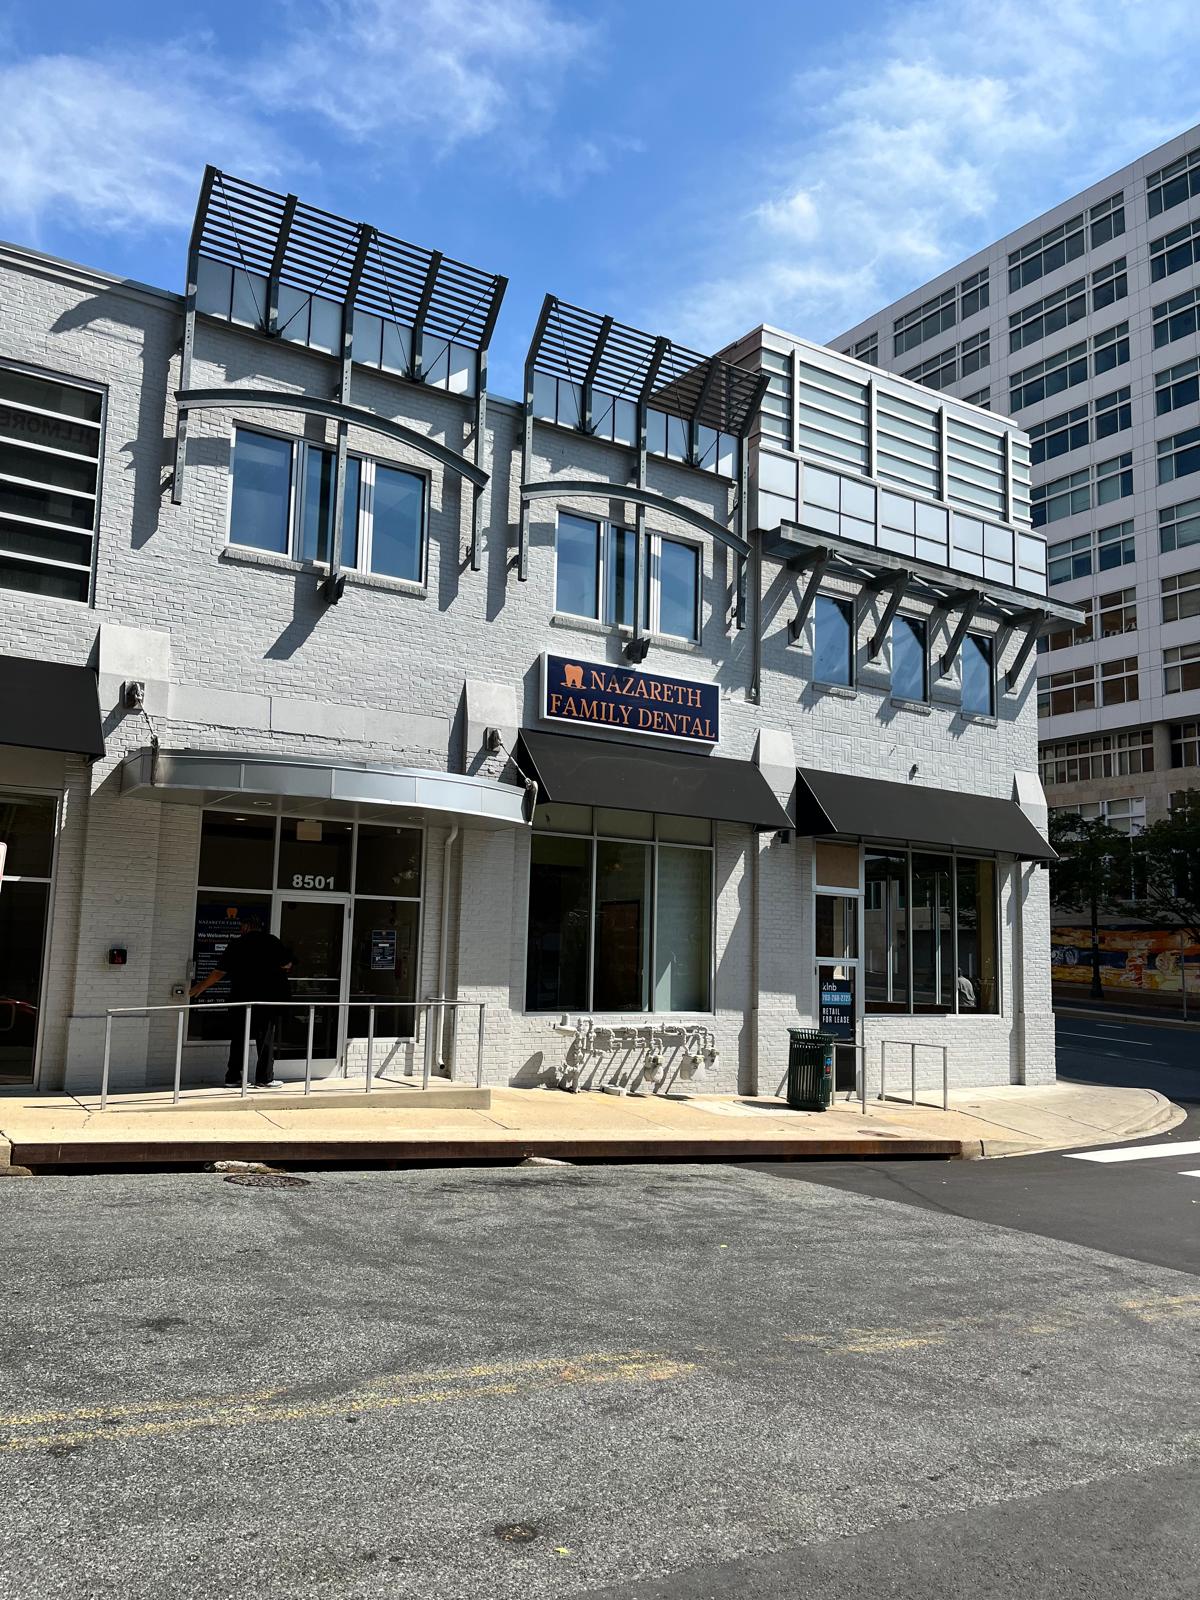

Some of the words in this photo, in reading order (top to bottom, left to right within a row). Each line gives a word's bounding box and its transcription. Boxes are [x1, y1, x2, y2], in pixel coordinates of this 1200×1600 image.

[591, 670, 702, 708] NAZARETH
[550, 693, 633, 725] FAMILY
[638, 708, 716, 738] DENTAL
[292, 874, 335, 890] 8501
[823, 1007, 840, 1015] RETAIL
[834, 1016, 850, 1024] LEASE
